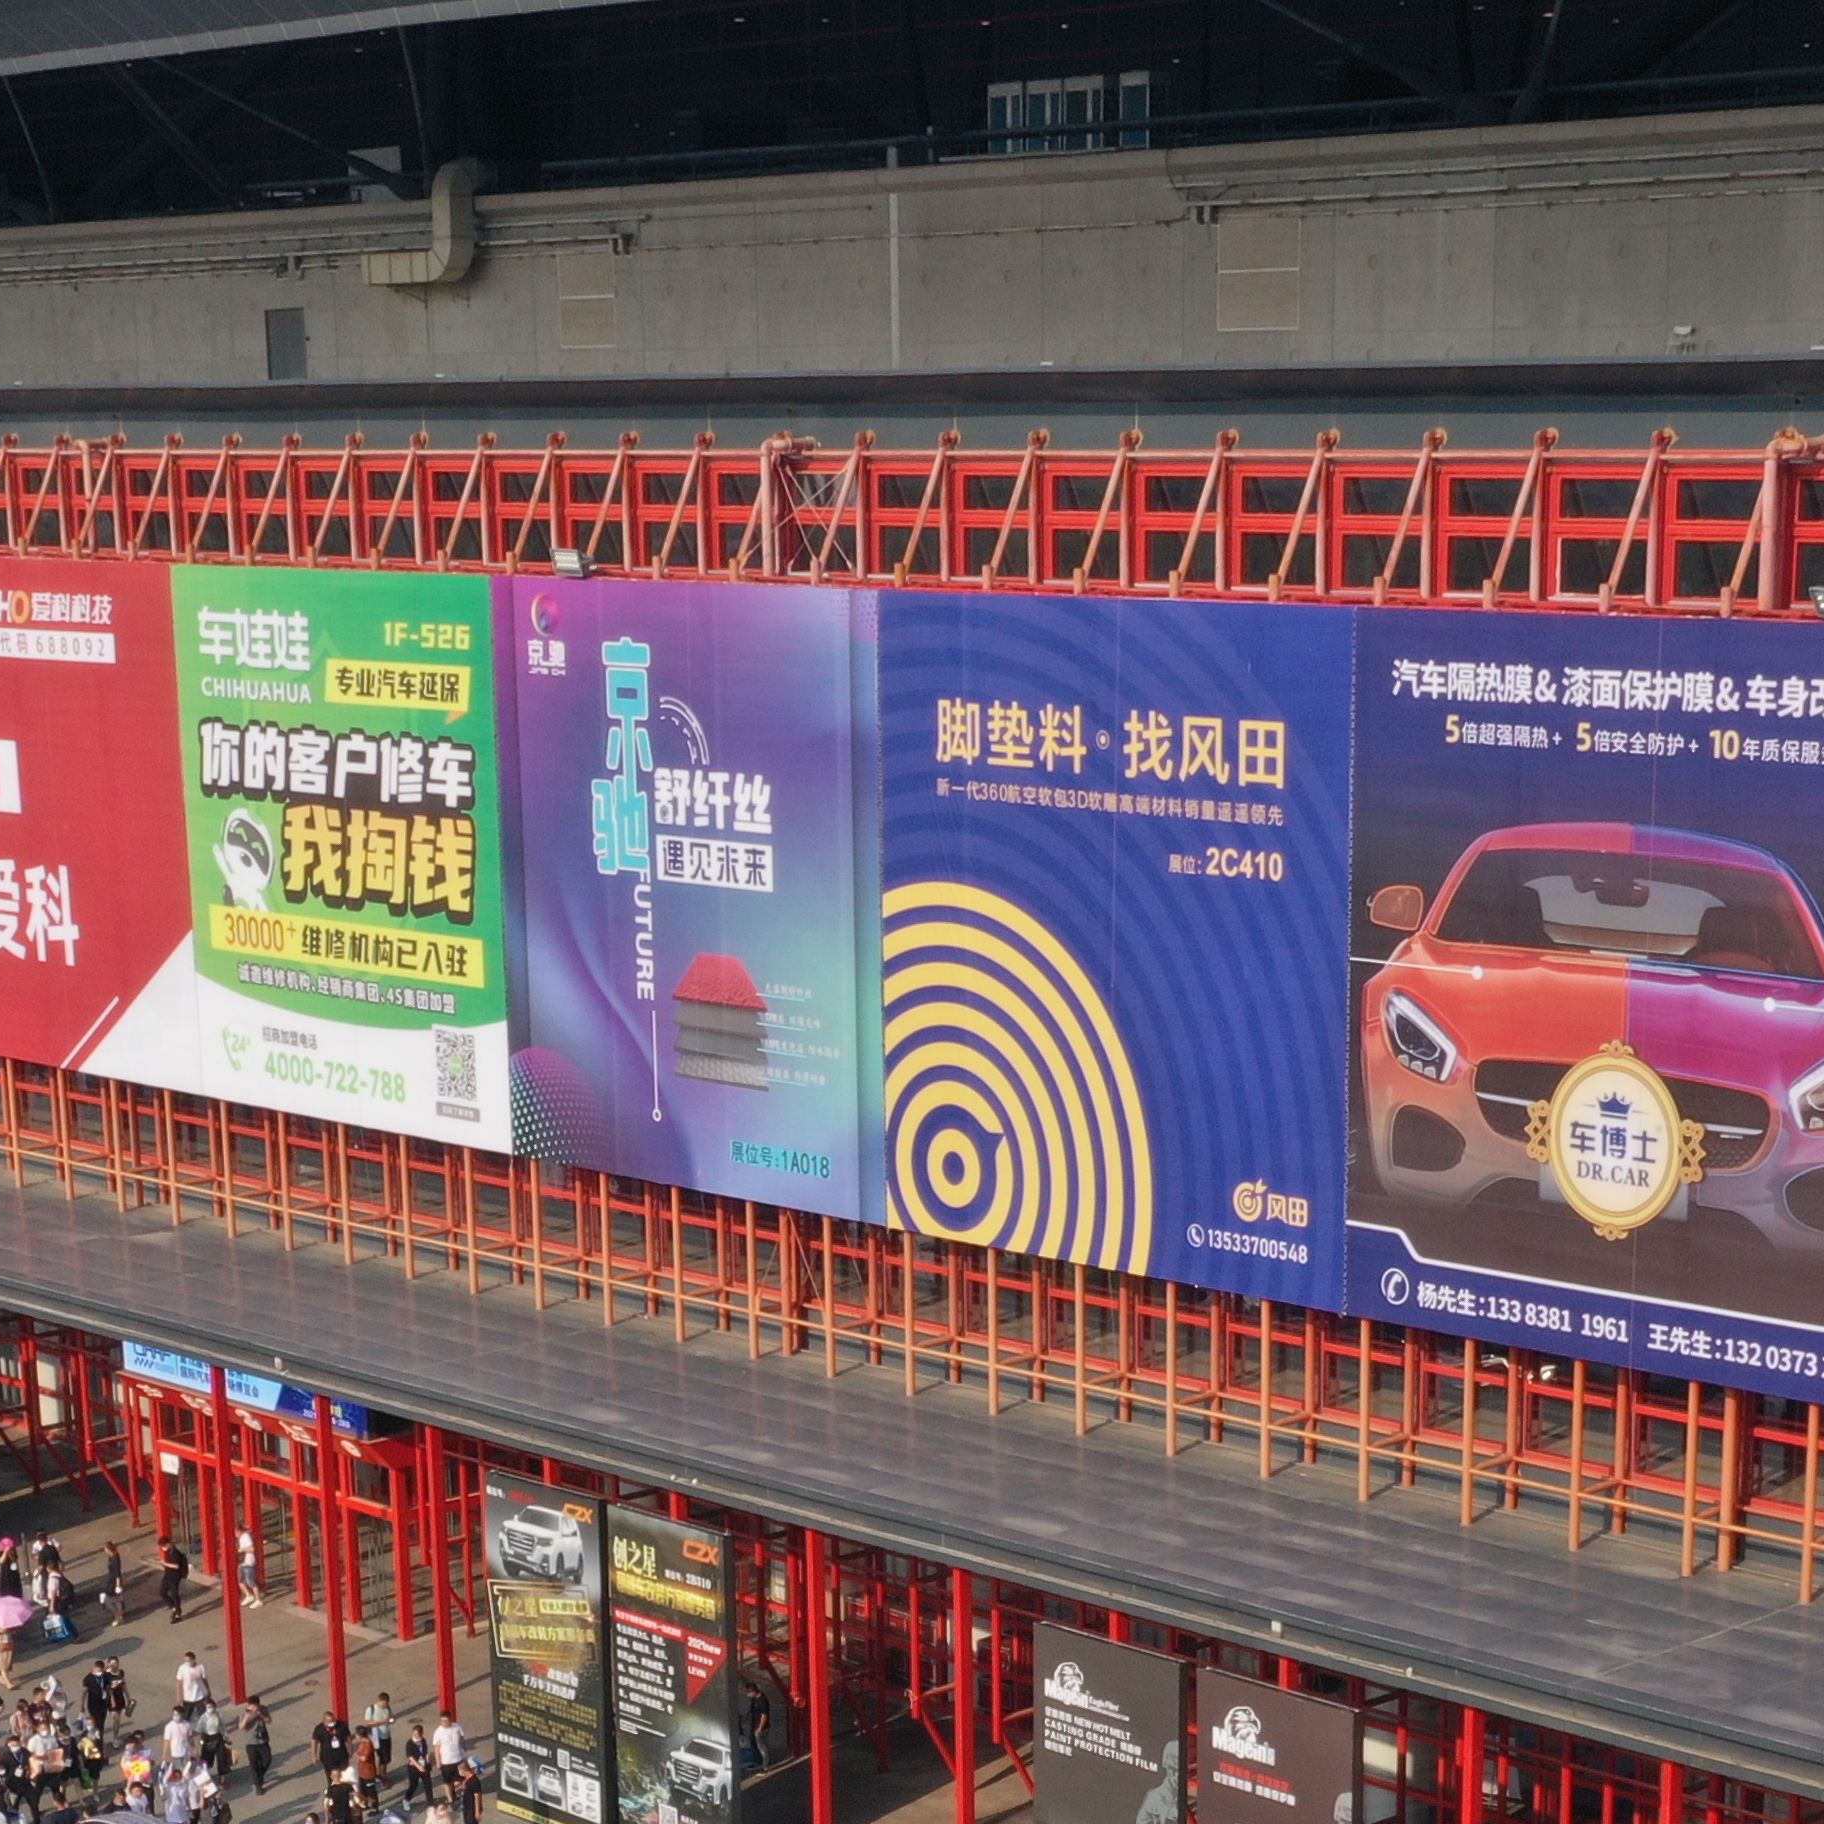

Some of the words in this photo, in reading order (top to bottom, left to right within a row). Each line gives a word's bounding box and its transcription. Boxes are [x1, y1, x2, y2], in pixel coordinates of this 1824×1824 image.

[35, 633, 107, 659] 688092
[197, 605, 310, 672] 车娃娃
[383, 621, 472, 651] 1F-526
[527, 638, 566, 668] 京驰
[200, 675, 312, 705] CHIHUAHUA
[335, 667, 460, 703] 专业汽车延保
[1392, 657, 1557, 704] 汽车隔热膜&
[1562, 665, 1740, 715] 漆面保护膜&
[198, 719, 475, 808] 你的客户修车
[590, 636, 654, 875] 京驰
[935, 696, 1087, 775] 脚垫料
[1123, 709, 1286, 790] 找风田
[653, 767, 773, 835] 舒纤丝
[283, 803, 474, 914] 我掏钱
[661, 840, 768, 888] 遇见未来
[1205, 845, 1284, 883] 2C410
[301, 922, 469, 978] 维修机构已入驻
[632, 868, 655, 1003] FUTURE
[262, 1026, 318, 1050] 招商加盟电话
[264, 1050, 407, 1104] 4000-722-788
[1568, 1116, 1659, 1165] 车博士
[1575, 1157, 1651, 1190] DR.CAR
[1265, 1191, 1308, 1229] 风田
[1207, 1227, 1308, 1266] 13533700548
[1524, 1299, 1573, 1334] 8381
[1580, 1312, 1630, 1345] 1961
[1764, 1343, 1819, 1377] 0373
[1044, 1717, 1085, 1738] CASTING
[1044, 1728, 1073, 1745] PAINT
[1074, 1738, 1134, 1765] PROTECTION
[1135, 1756, 1159, 1773] FILM
